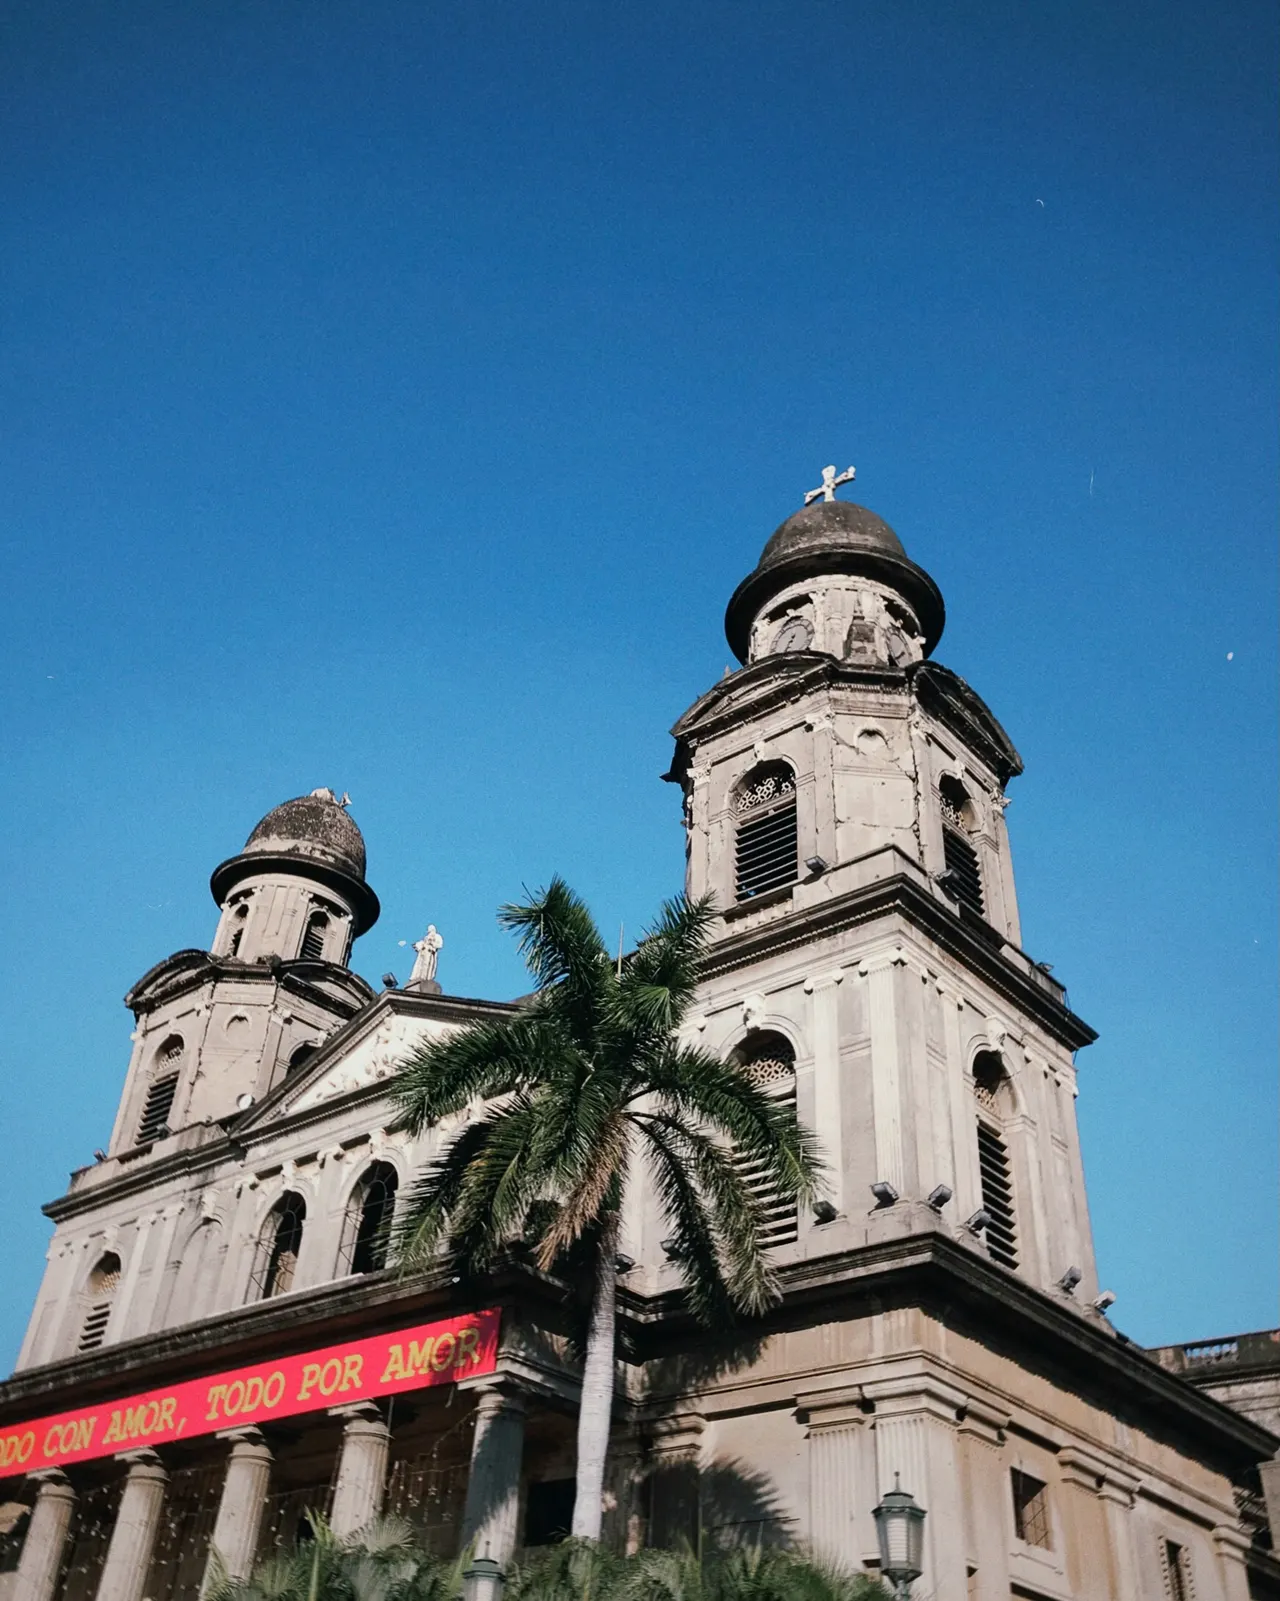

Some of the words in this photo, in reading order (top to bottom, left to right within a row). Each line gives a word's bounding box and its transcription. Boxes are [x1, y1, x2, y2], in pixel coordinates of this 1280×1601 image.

[0, 1431, 36, 1467] DO
[43, 1416, 98, 1457] CON
[102, 1397, 187, 1444] AMOR,
[205, 1371, 285, 1420] TODO
[297, 1354, 363, 1401] POR
[380, 1328, 481, 1383] AMOR
